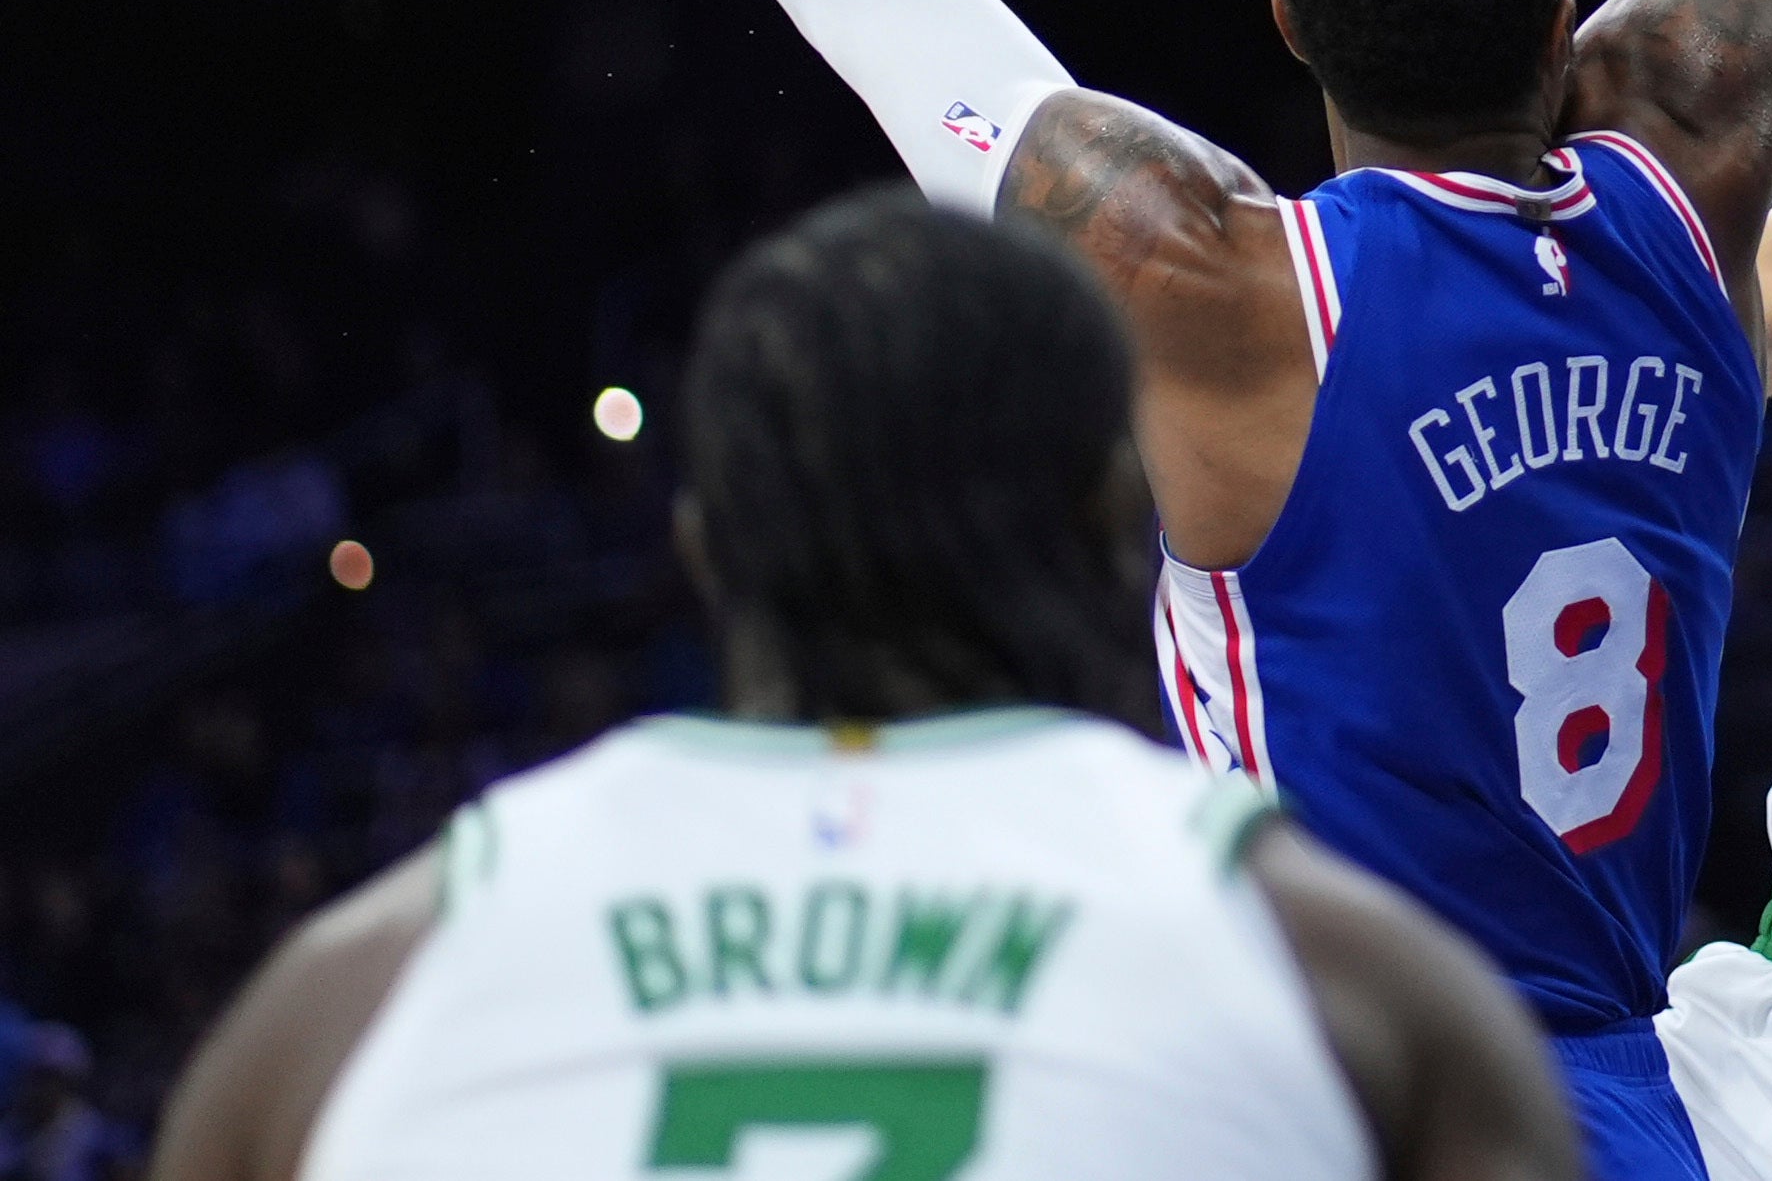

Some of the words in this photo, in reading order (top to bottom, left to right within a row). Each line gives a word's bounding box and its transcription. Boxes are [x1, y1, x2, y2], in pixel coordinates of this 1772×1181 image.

[1408, 354, 1704, 512] GEORGE
[1502, 536, 1669, 856] 8
[604, 875, 1082, 1023] BROWN
